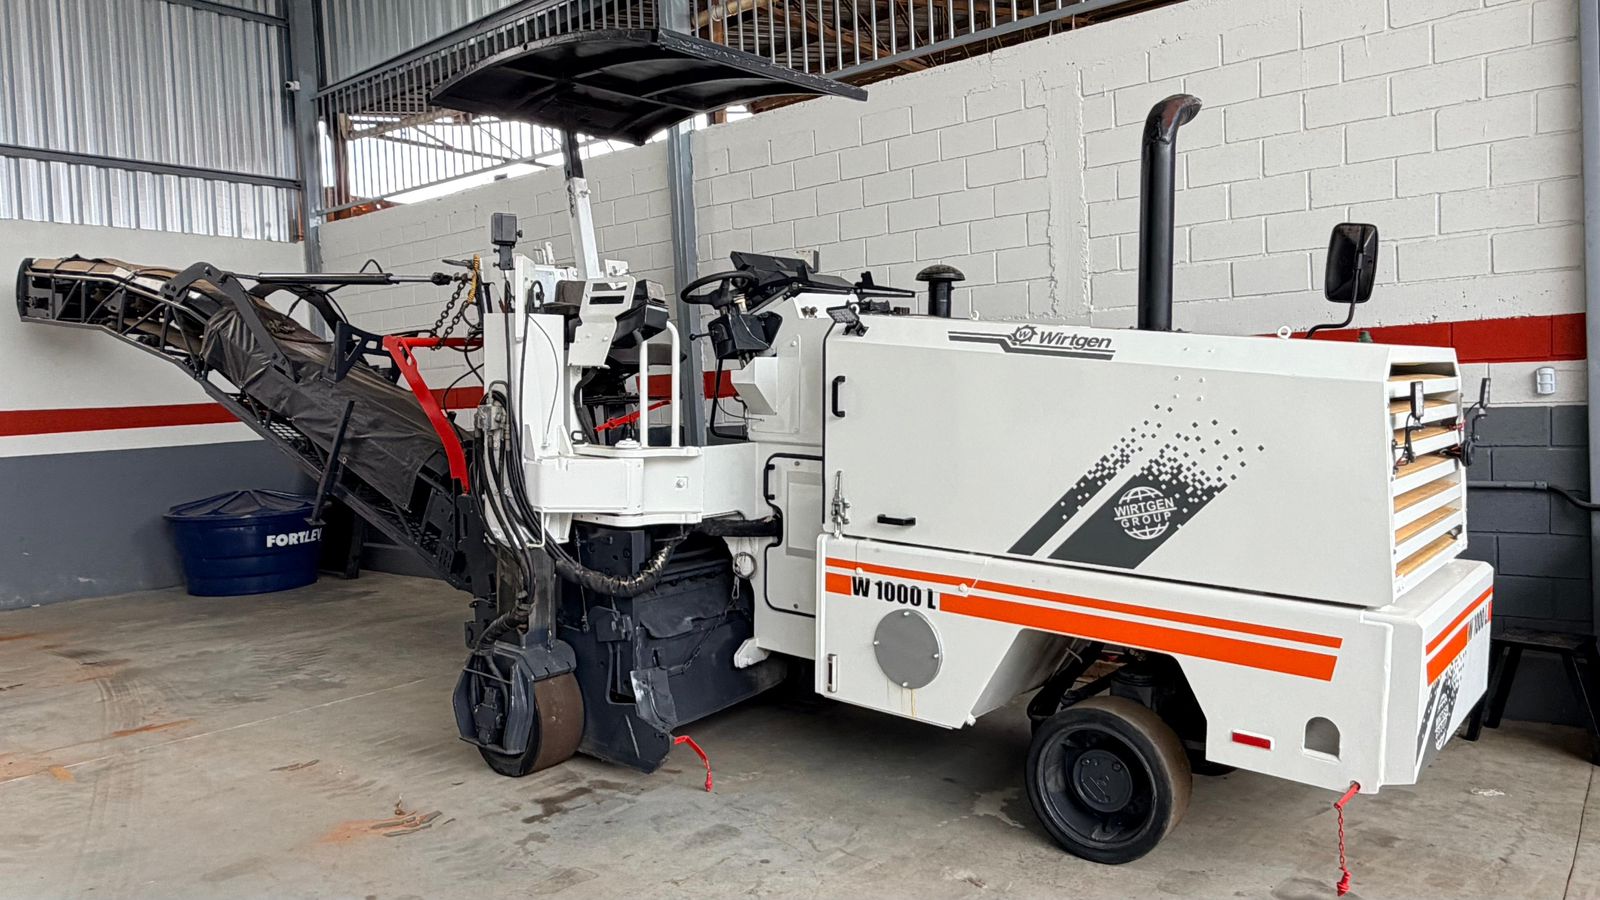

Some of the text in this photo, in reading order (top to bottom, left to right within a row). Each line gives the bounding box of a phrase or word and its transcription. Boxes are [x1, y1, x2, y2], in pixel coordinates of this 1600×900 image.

[1039, 331, 1112, 350] Wirtgen
[1114, 497, 1175, 517] WIRTGEN
[1121, 511, 1171, 528] GROUP
[266, 528, 322, 548] FORTLEV
[852, 576, 936, 610] W 1000 L
